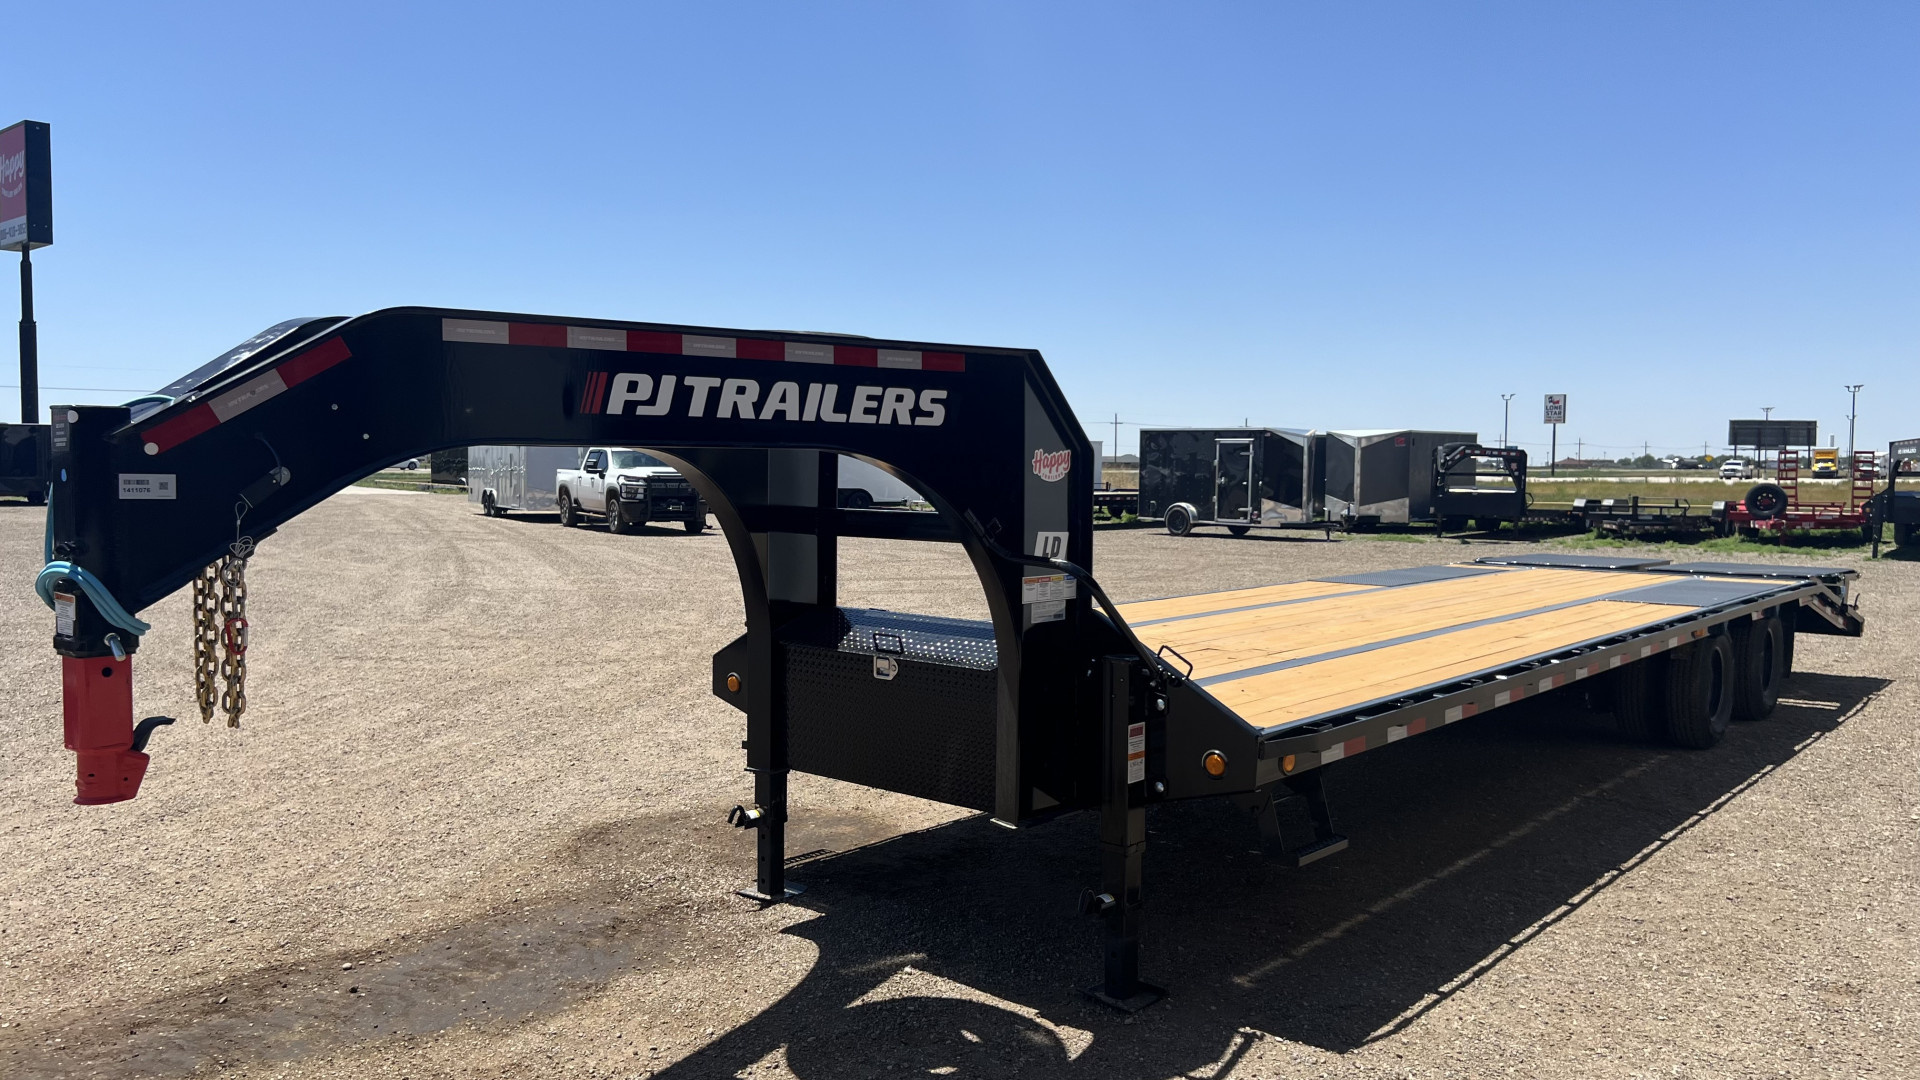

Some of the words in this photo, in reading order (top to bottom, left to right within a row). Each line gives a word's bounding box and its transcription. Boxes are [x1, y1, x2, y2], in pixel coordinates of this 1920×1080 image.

[683, 375, 948, 427] TRAILERS
[1033, 449, 1071, 475] Happy
[1041, 535, 1062, 558] LD
